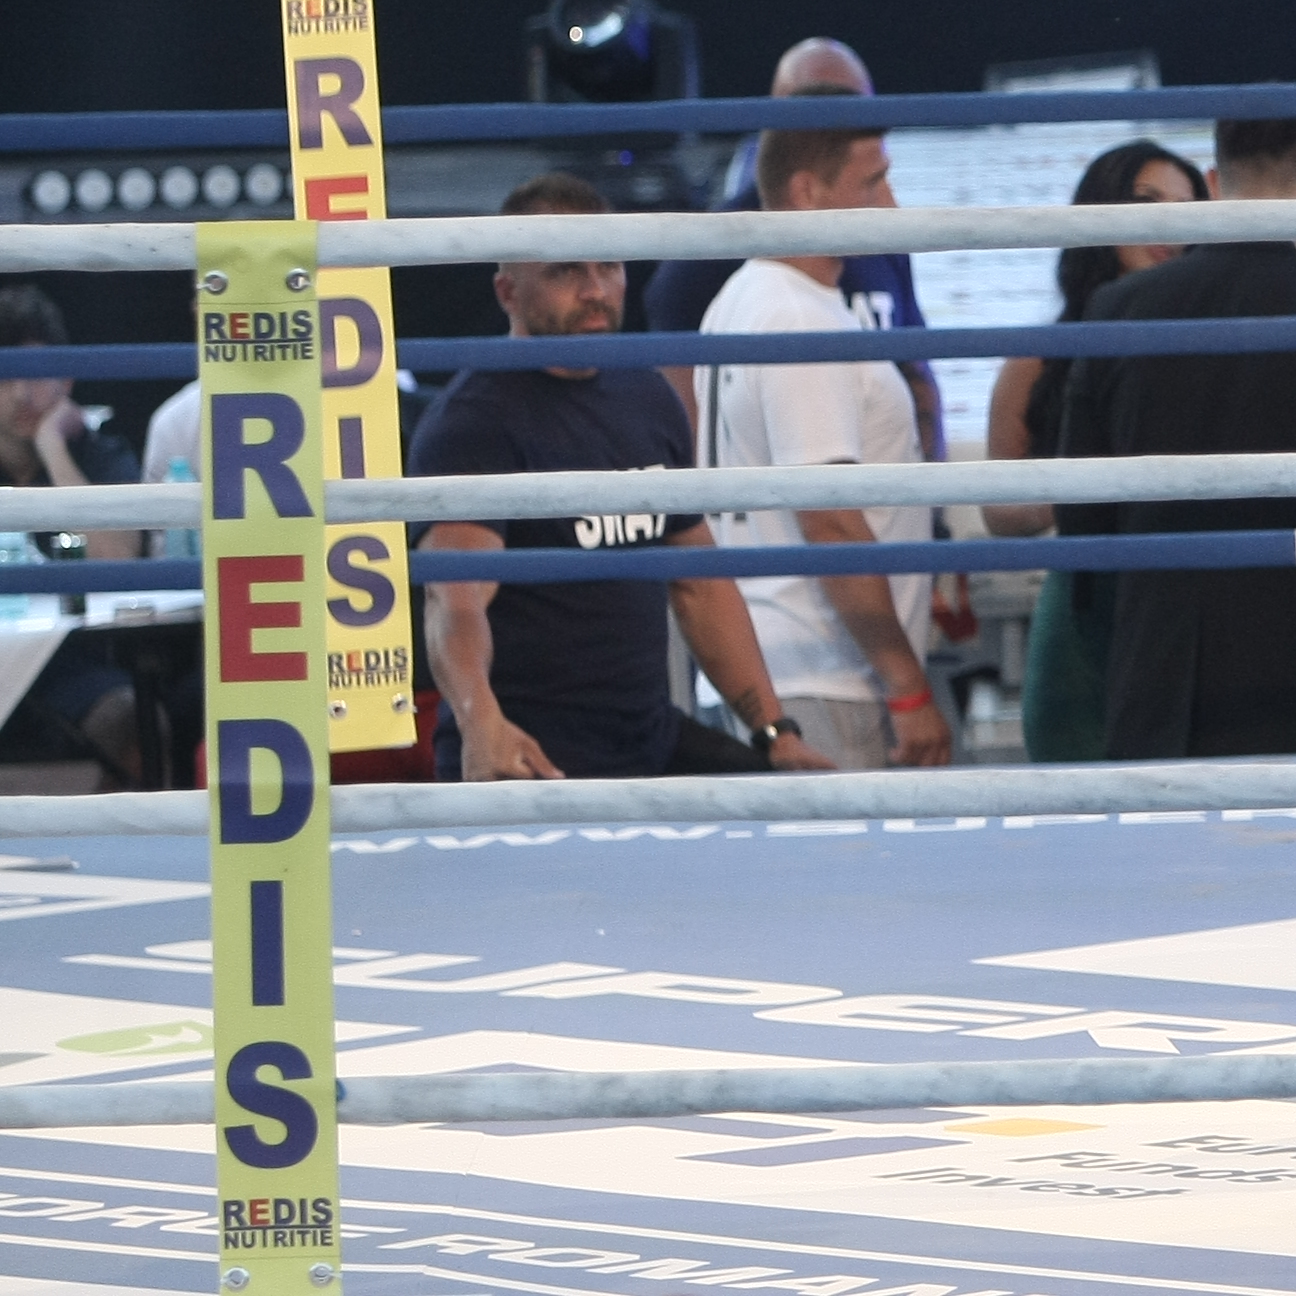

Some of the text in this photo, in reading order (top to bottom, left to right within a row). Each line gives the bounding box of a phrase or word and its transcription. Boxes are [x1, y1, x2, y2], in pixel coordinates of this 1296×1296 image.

[287, 17, 369, 36] NUTRITIE
[204, 310, 314, 343] REDIS
[204, 340, 314, 364] NUTRITIE
[328, 647, 408, 673] REDIS
[209, 392, 319, 1169] REDIS
[872, 1166, 1192, 1200] Invest
[223, 1197, 333, 1226] REDIS
[223, 1225, 333, 1250] NUTRITIE
